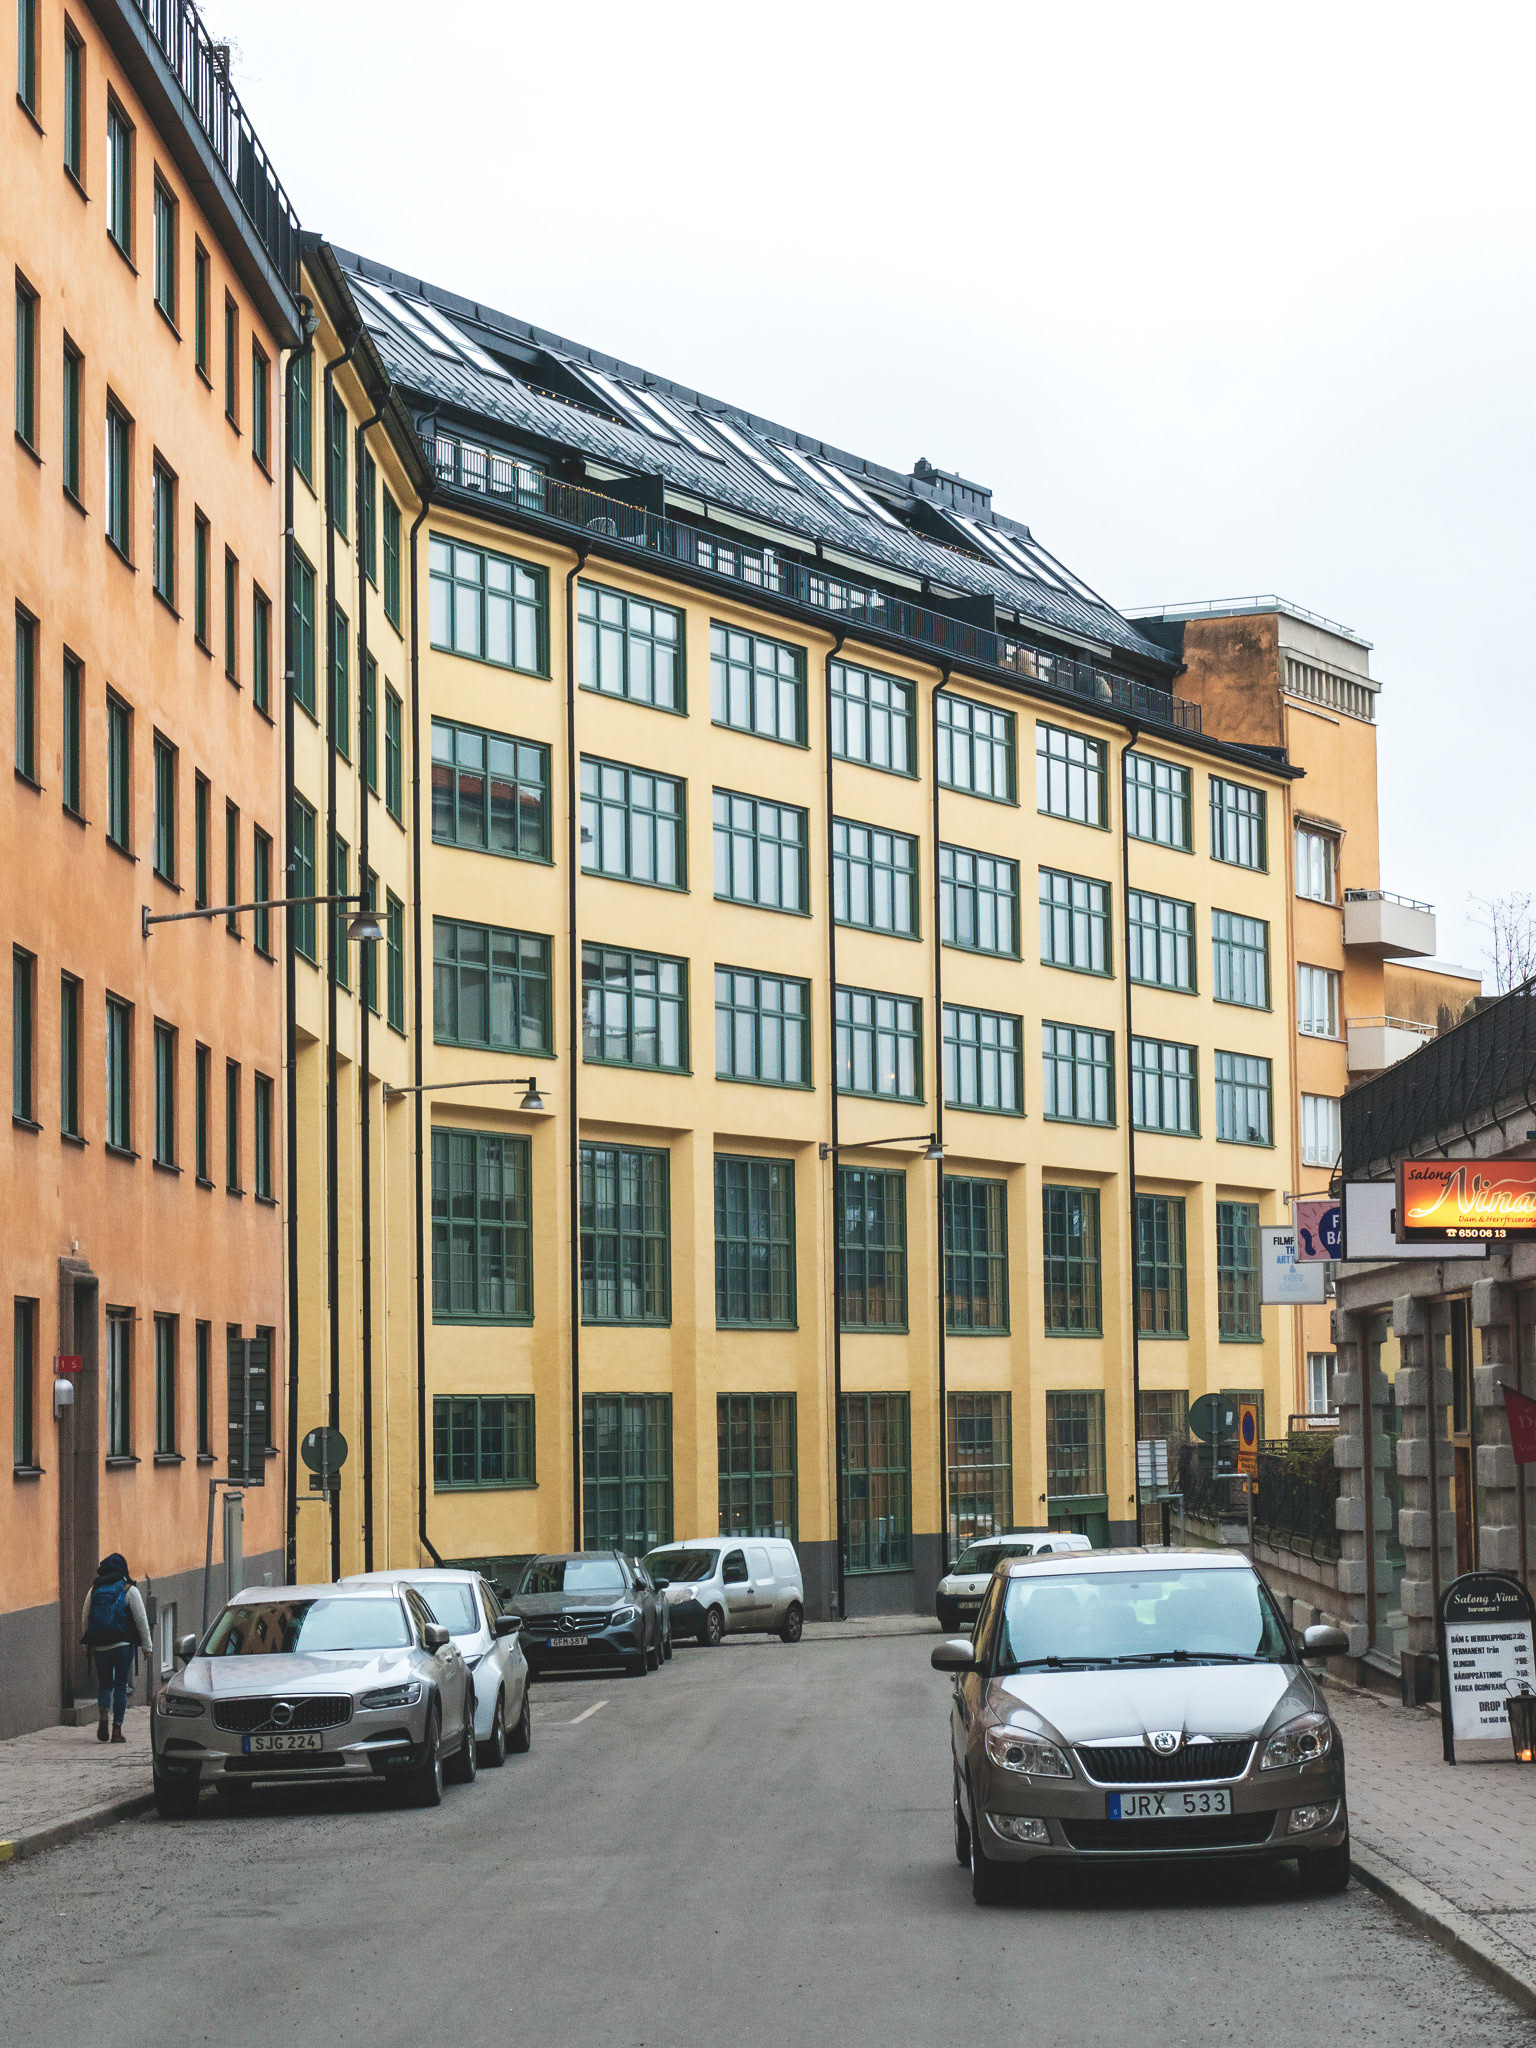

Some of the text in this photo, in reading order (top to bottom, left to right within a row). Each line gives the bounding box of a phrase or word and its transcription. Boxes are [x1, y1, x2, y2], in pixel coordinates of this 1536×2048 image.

[1408, 1165, 1536, 1218] Salong Nina
[1458, 1229, 1507, 1238] 650 06 13
[1276, 1255, 1290, 1264] ART
[1289, 1264, 1296, 1273] &
[1454, 1592, 1518, 1606] Salong Nina
[1452, 1647, 1485, 1655] PERMANENT
[1453, 1660, 1476, 1668] SLINGOR
[1478, 1701, 1501, 1712] DROP
[255, 1734, 316, 1750] SJG 224
[1124, 1792, 1226, 1816] JRX 533
